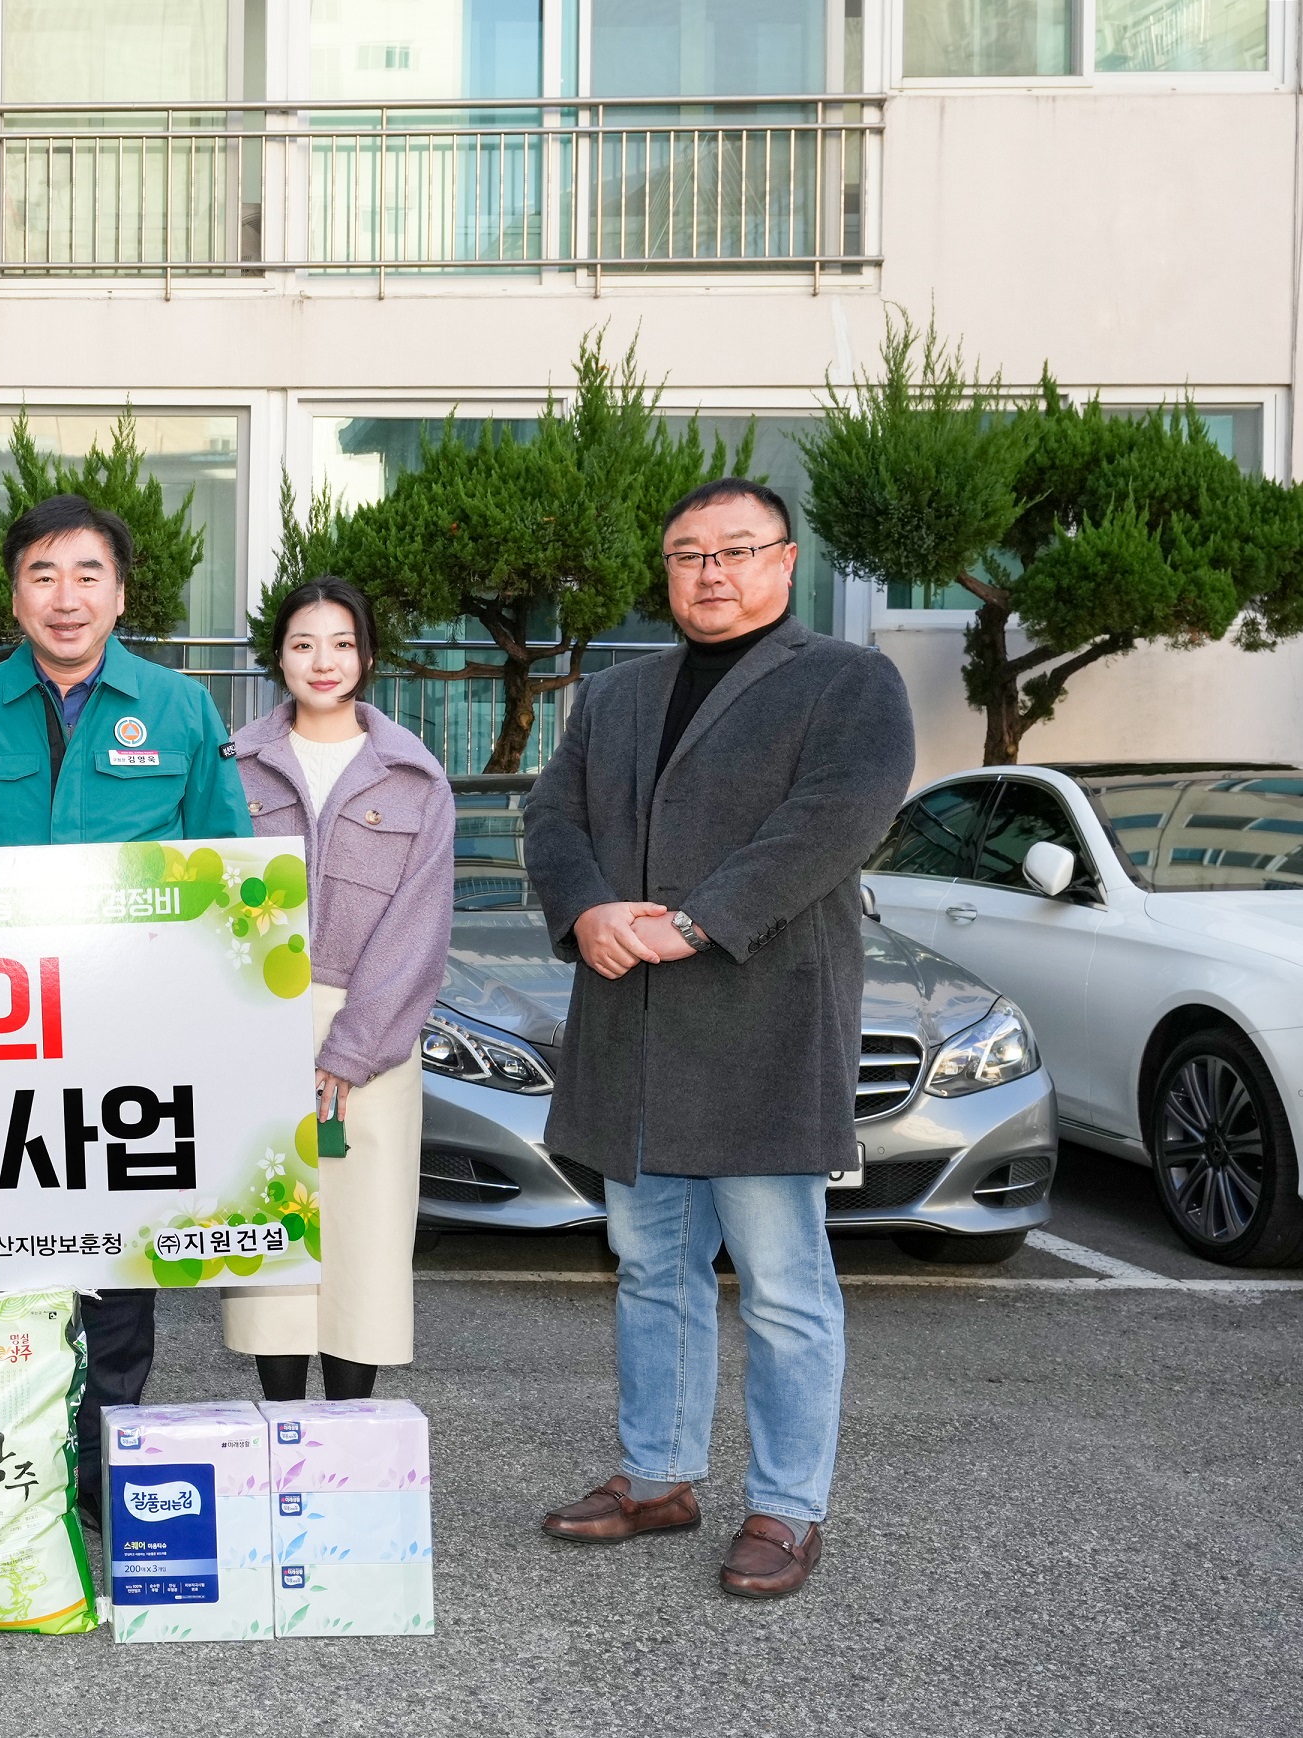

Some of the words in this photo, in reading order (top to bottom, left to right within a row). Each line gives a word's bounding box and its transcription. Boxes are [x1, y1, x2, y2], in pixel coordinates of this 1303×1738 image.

[9, 1333, 30, 1346] 명실
[4, 1344, 33, 1364] 상주
[130, 1490, 192, 1514] 잘풀리는집
[123, 1541, 146, 1550] 스퀘어
